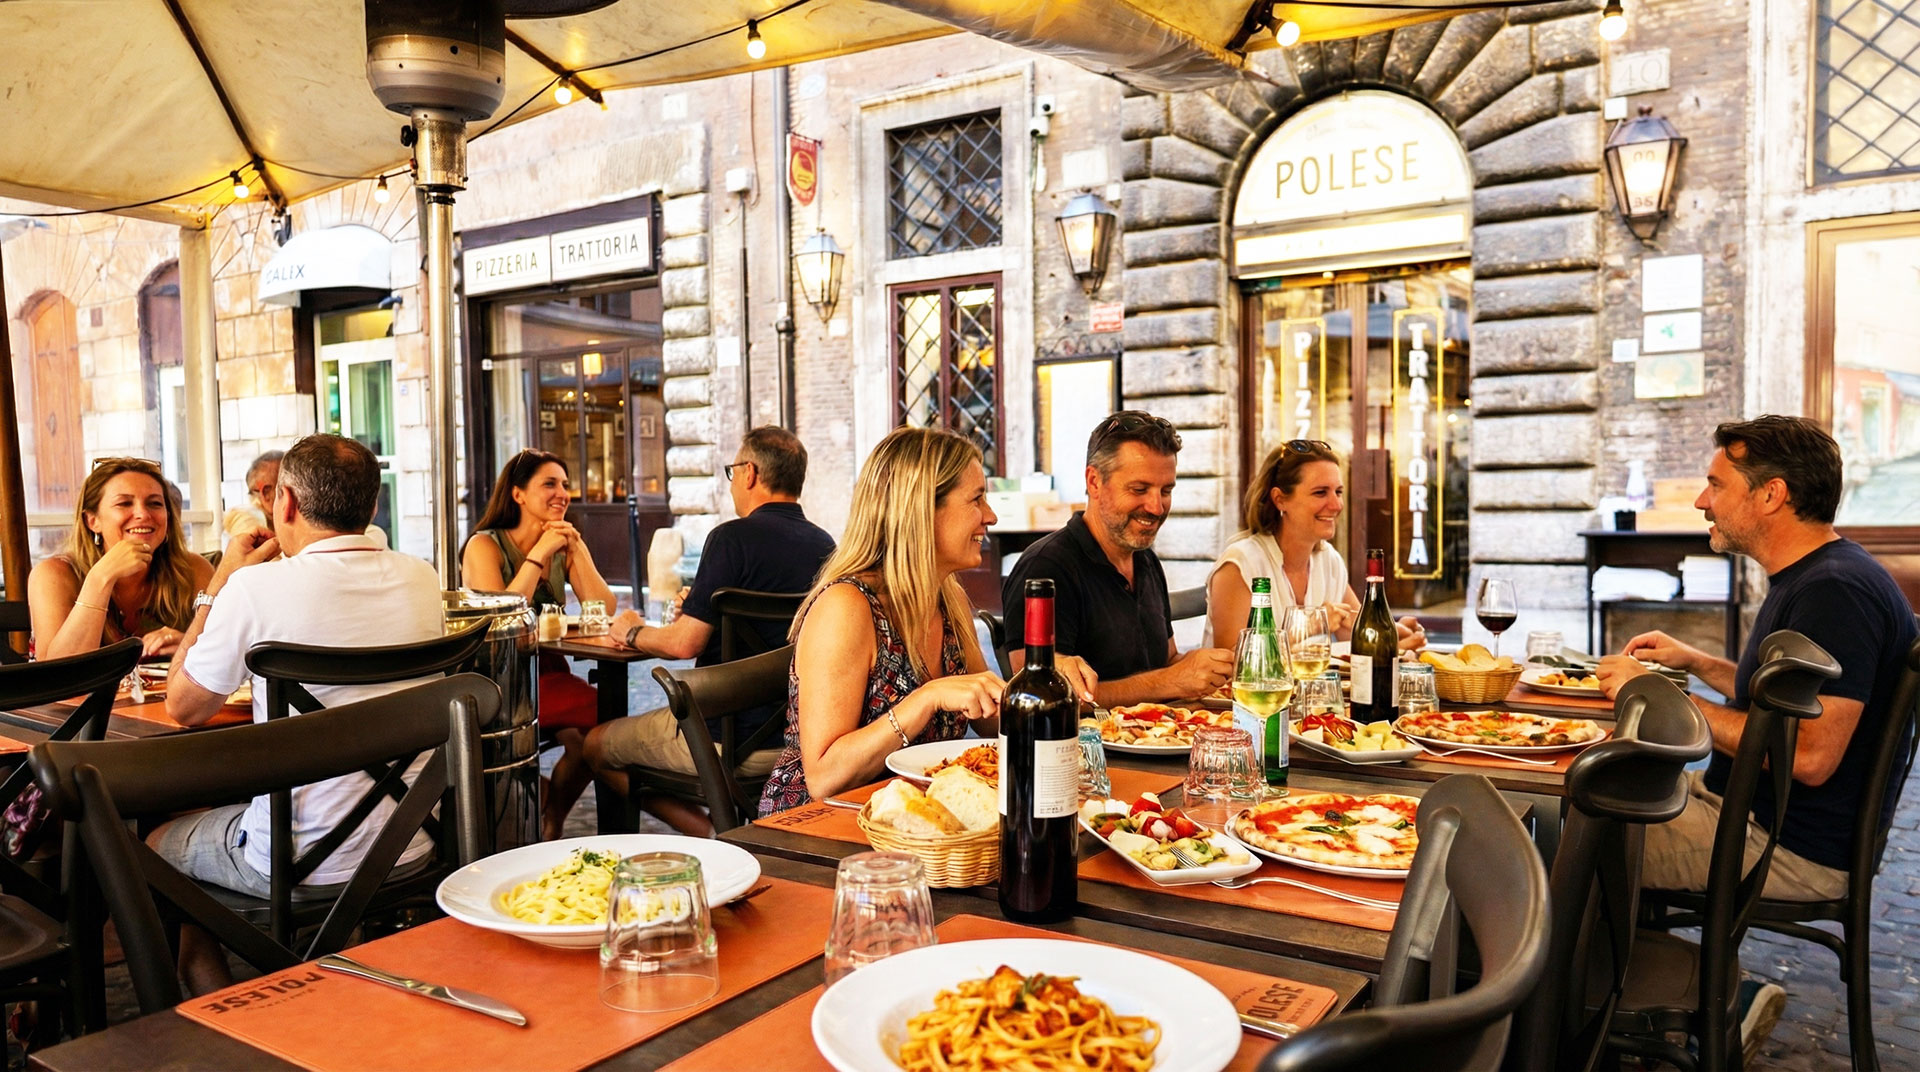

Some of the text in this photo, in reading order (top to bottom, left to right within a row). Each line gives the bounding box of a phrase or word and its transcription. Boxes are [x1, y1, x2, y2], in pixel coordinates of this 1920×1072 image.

[1617, 58, 1664, 87] 40
[1276, 140, 1419, 199] POLESE
[475, 233, 639, 280] PIZZERIA TRATTORIA
[1407, 322, 1429, 565] TRATTORIA
[200, 971, 327, 1014] POLESE
